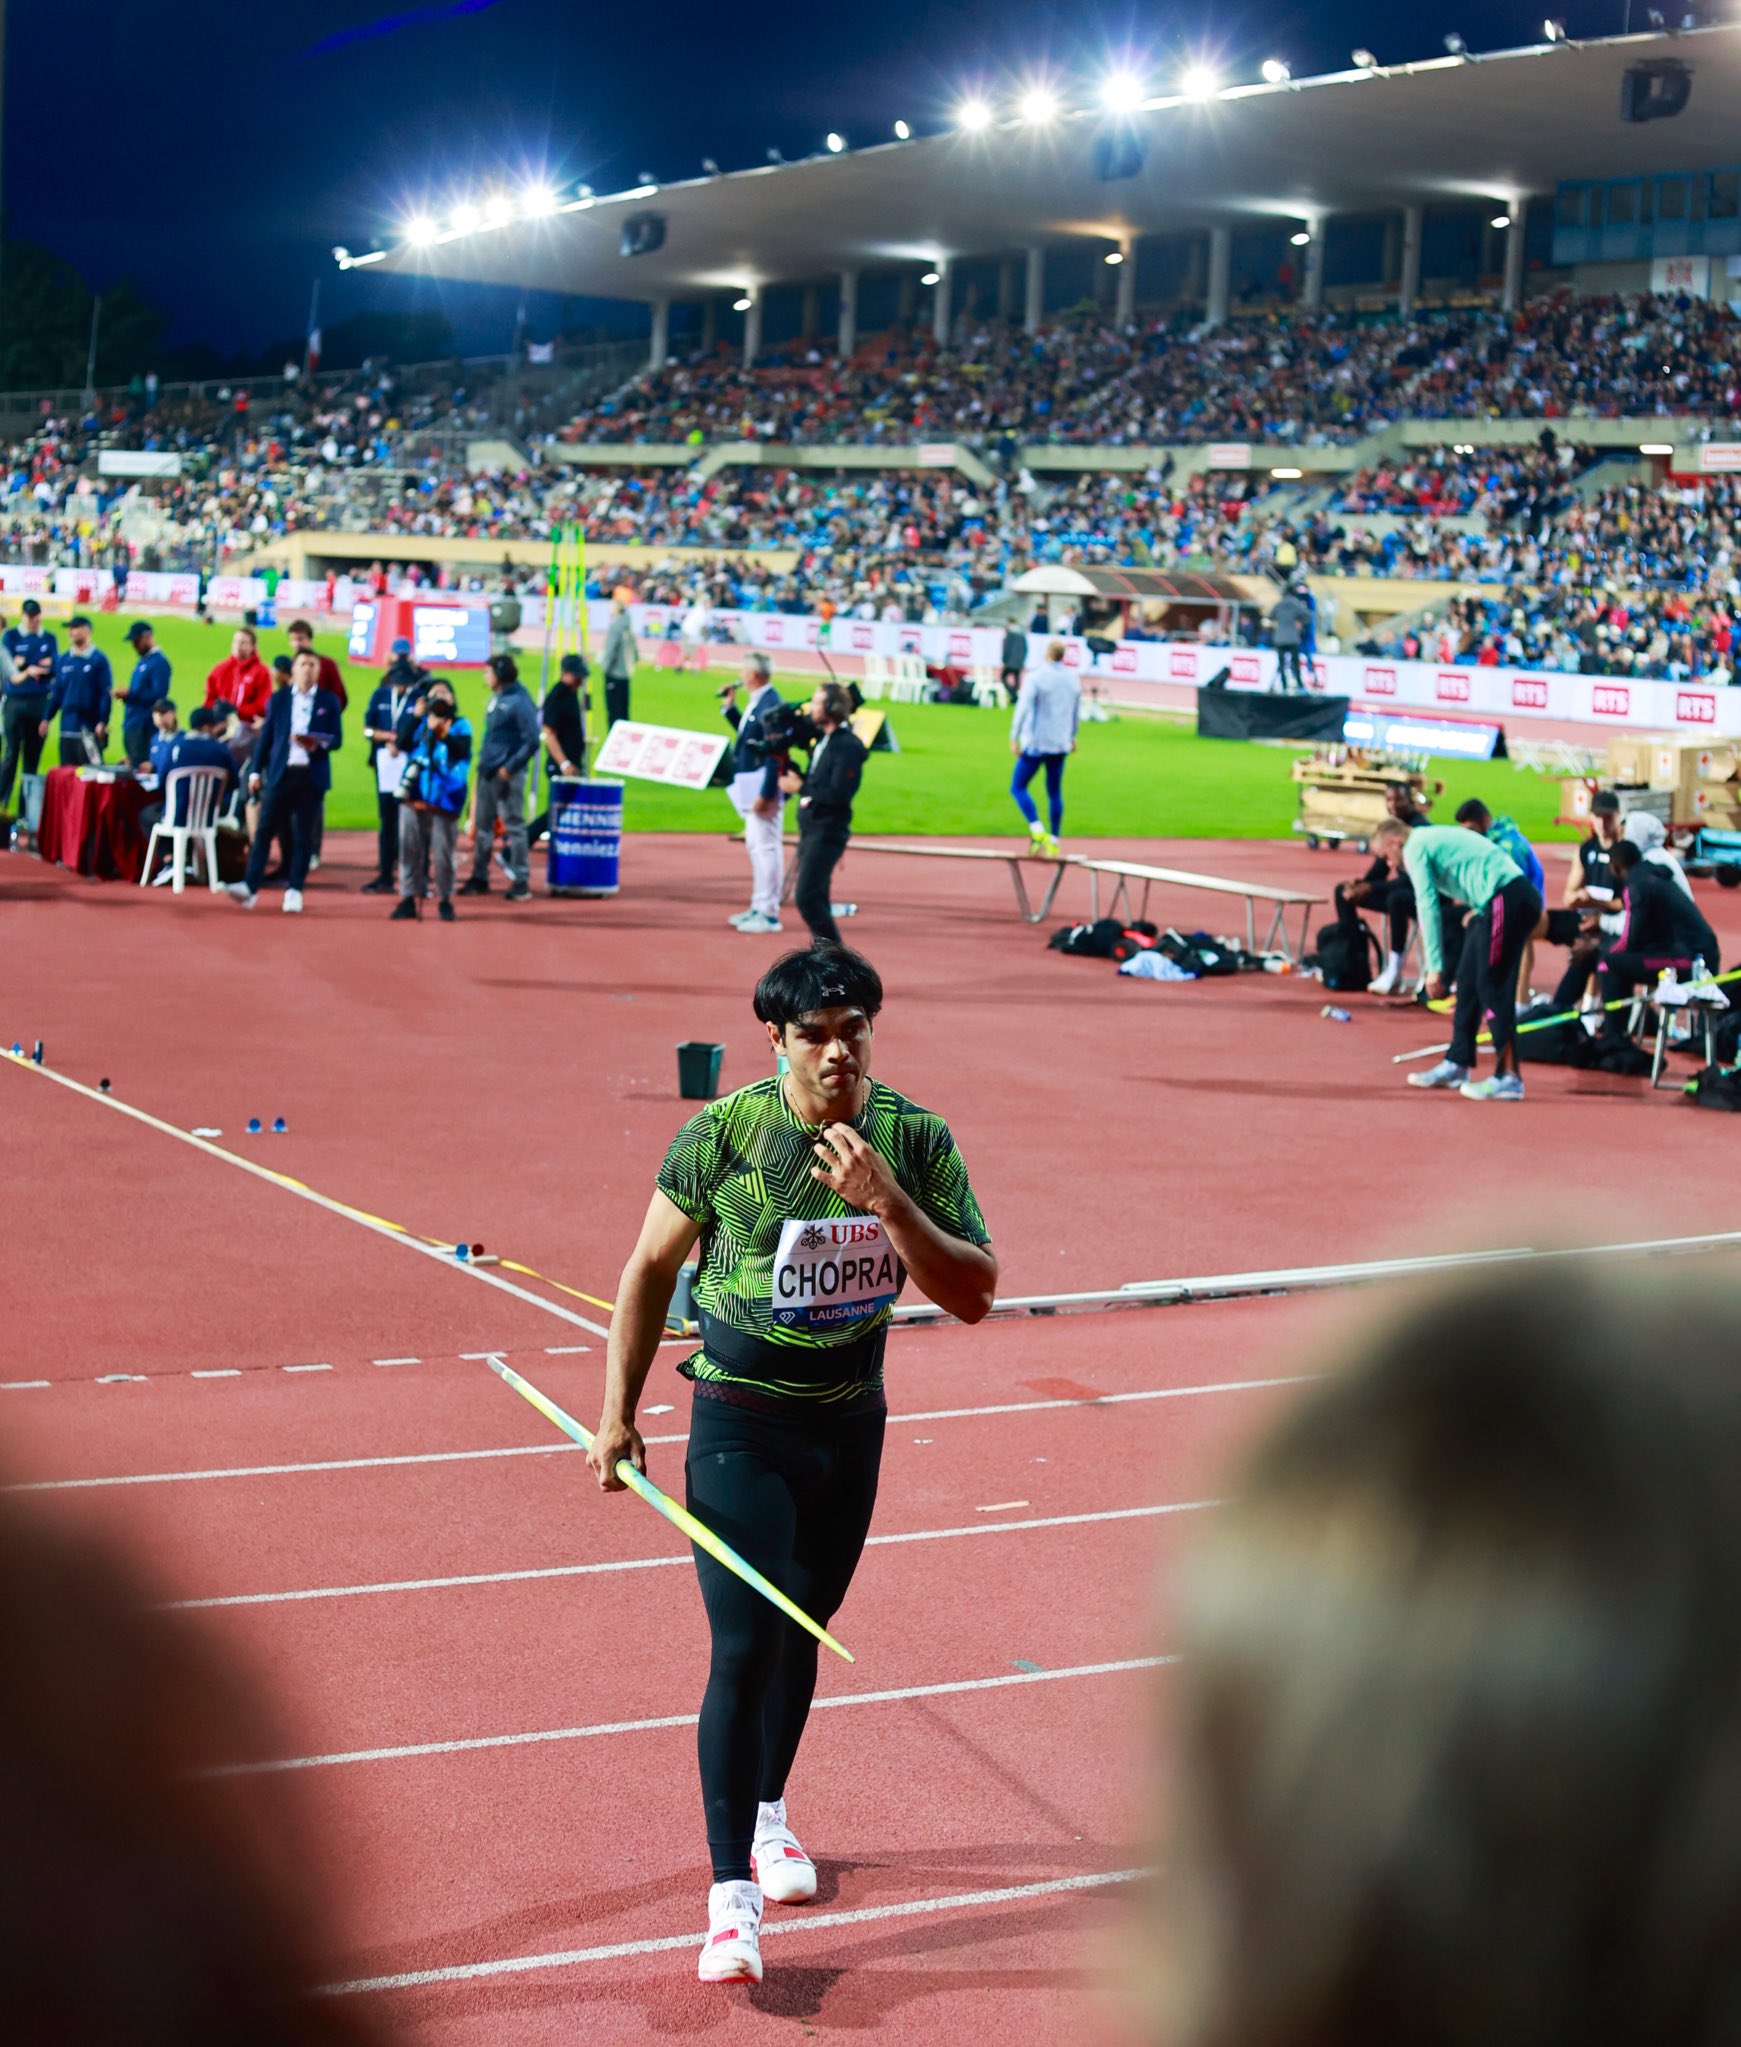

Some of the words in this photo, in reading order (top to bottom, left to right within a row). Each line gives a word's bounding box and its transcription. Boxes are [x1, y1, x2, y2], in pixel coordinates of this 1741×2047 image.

[1438, 675, 1469, 700] RTS
[1513, 682, 1547, 707] RTS
[1593, 688, 1629, 714] RTS
[1677, 695, 1715, 722] RTS
[831, 1223, 879, 1245] UBS
[778, 1253, 893, 1299] CHOPRA
[809, 1302, 875, 1321] LAUSANNE
